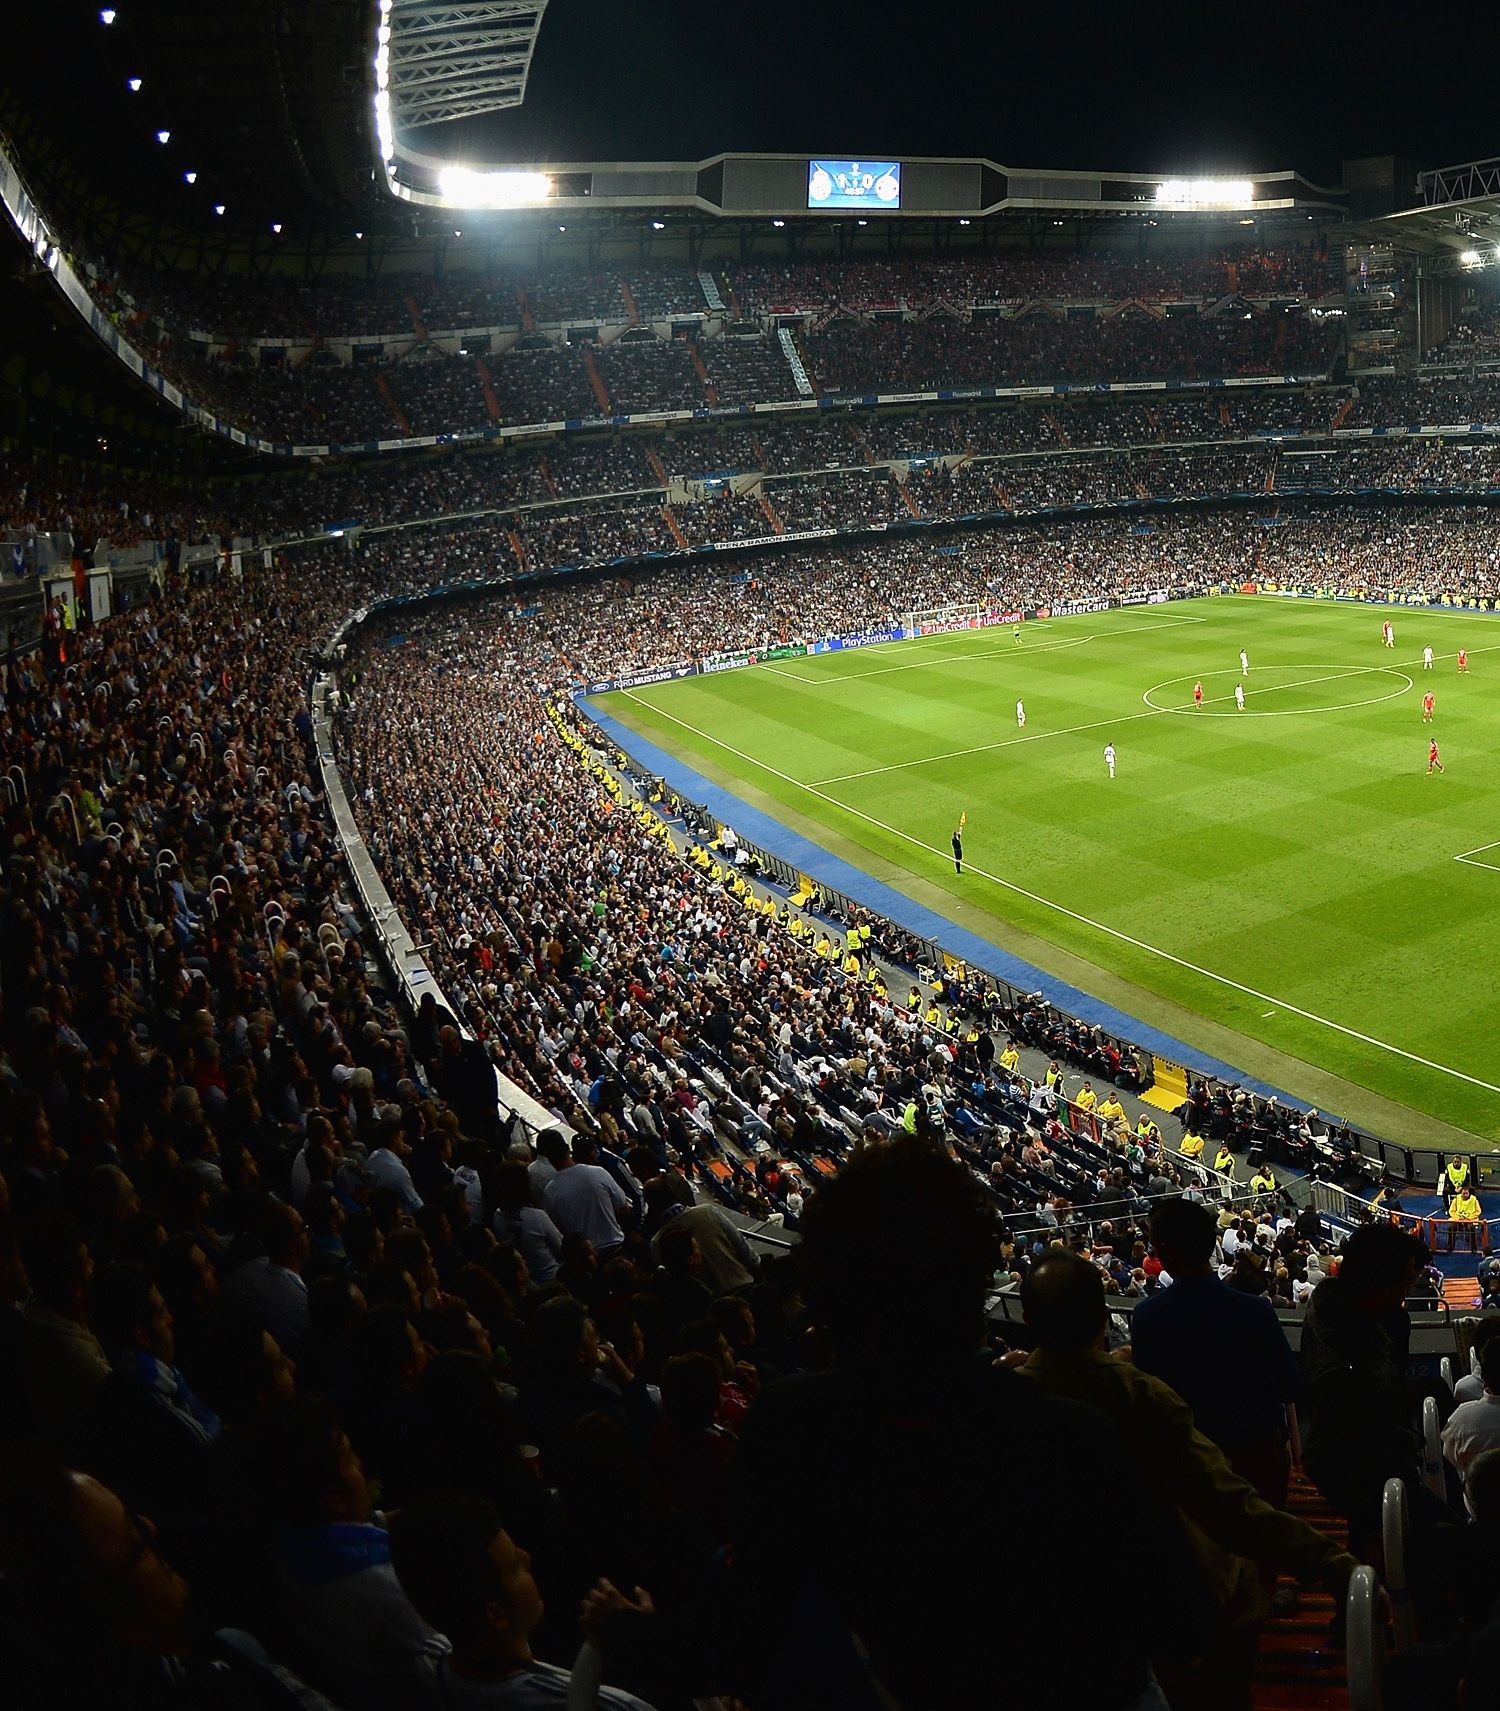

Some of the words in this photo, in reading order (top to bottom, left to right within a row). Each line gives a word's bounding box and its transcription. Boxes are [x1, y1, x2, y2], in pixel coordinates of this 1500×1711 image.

[783, 530, 831, 541] MENDOZA
[1051, 600, 1109, 617] MasterCard
[932, 620, 970, 634] UniCredit
[983, 613, 1021, 626] UniCredit
[841, 632, 893, 648] PlayStation
[702, 658, 749, 673] Heineken
[613, 679, 634, 689] FORD
[634, 671, 672, 685] MUSTANG
